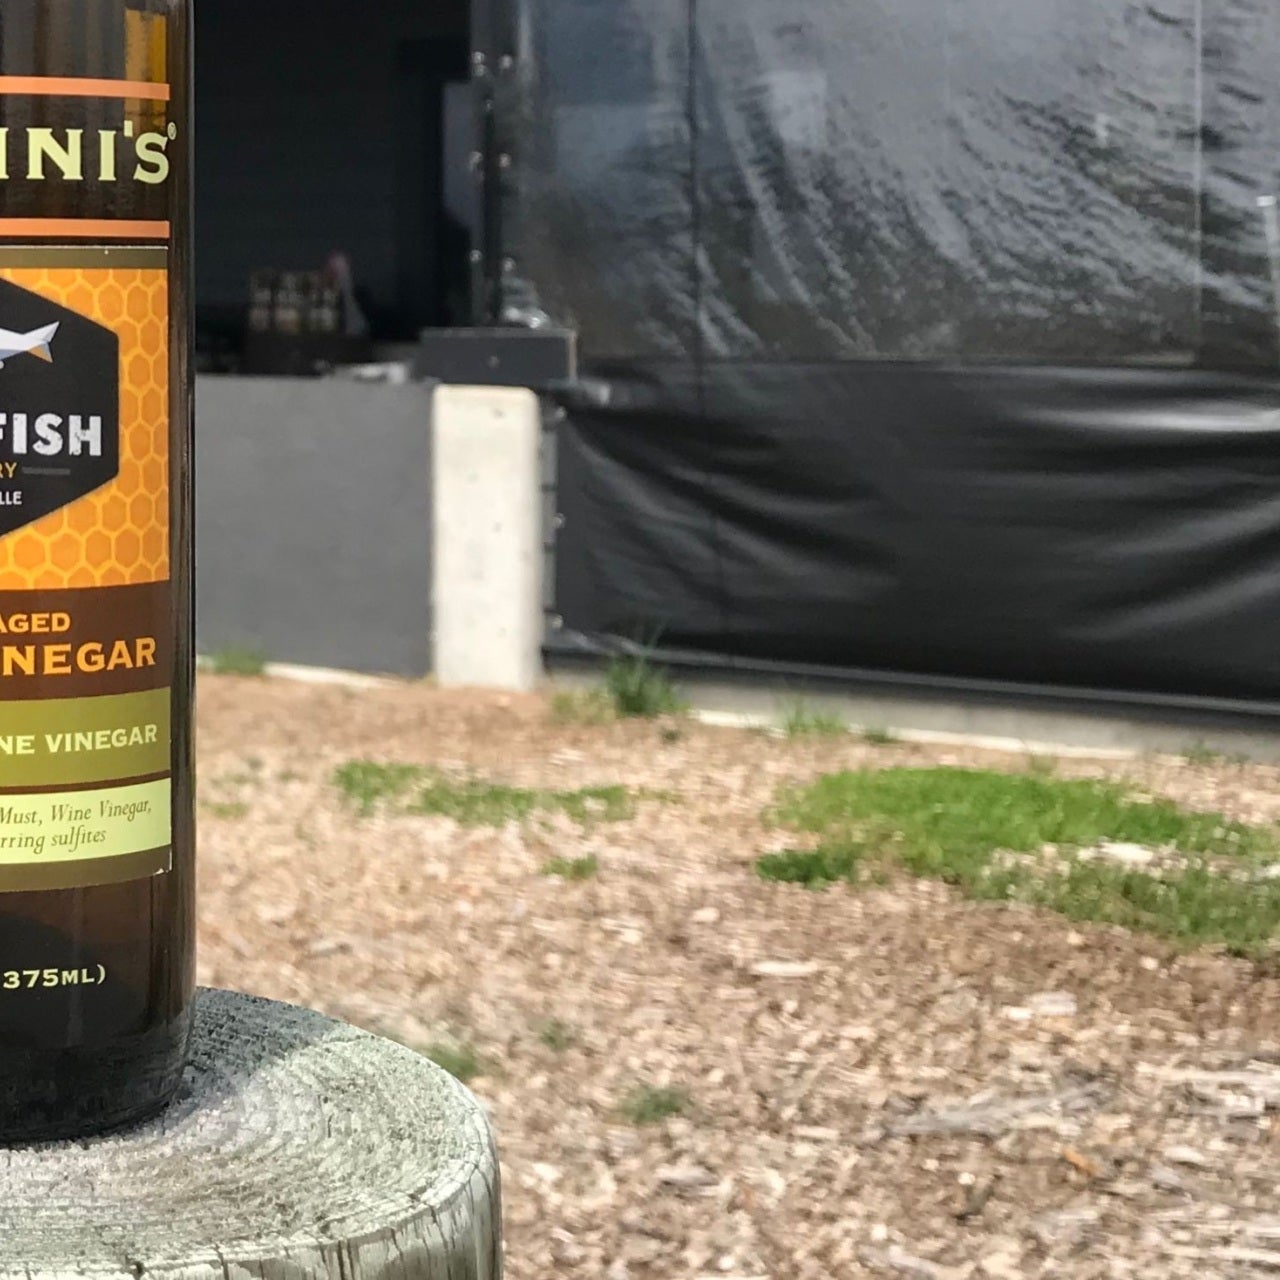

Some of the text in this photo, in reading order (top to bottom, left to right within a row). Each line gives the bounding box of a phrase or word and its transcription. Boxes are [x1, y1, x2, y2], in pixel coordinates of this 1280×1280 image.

[45, 724, 157, 754] VINEGAR
[51, 803, 92, 822] Wine
[99, 799, 152, 821] Vinegar,
[51, 825, 106, 854] sulfites
